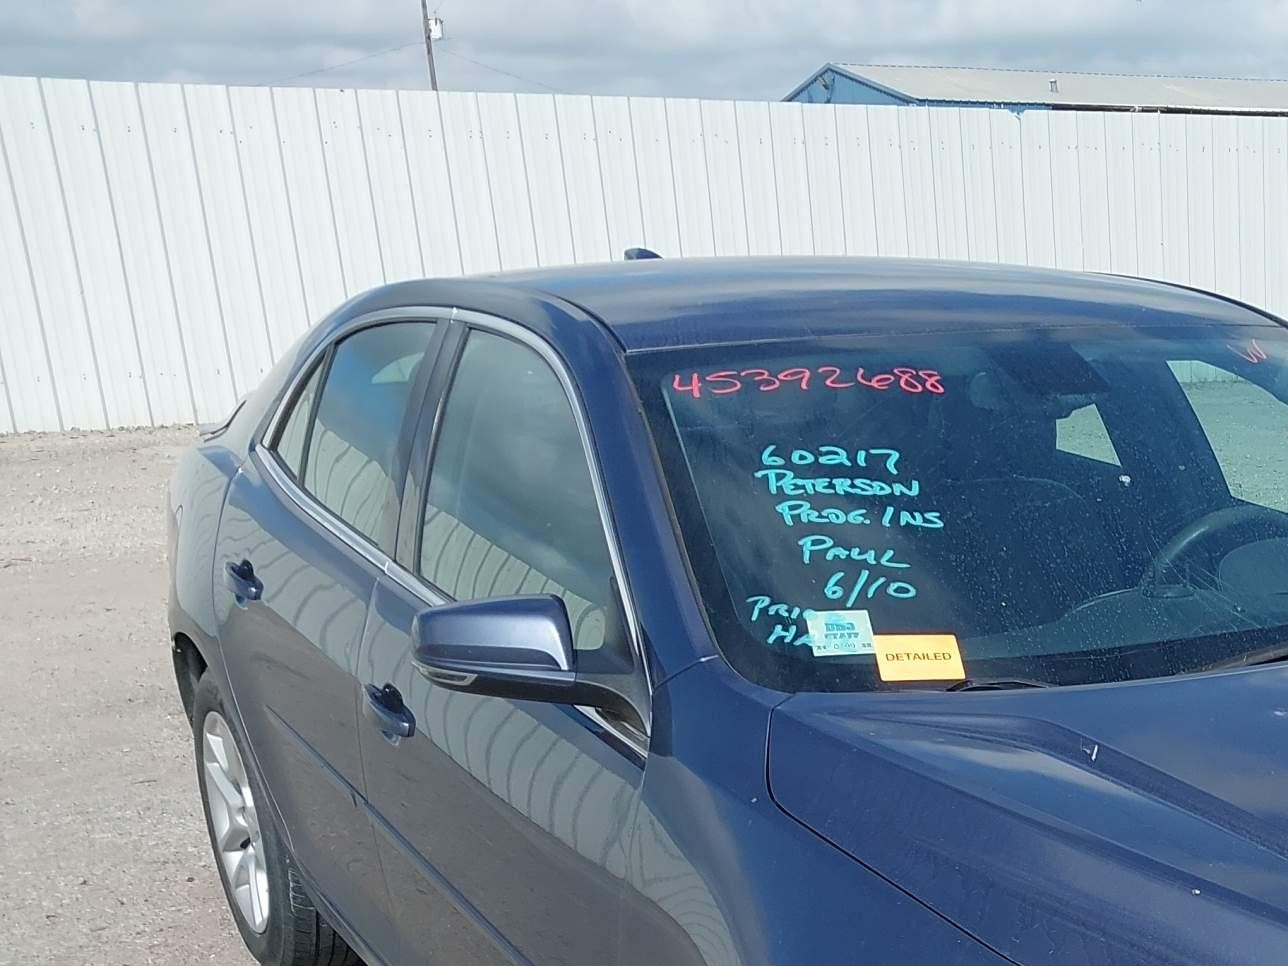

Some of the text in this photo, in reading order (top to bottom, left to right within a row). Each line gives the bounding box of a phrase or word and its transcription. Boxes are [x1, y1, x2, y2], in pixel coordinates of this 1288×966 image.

[672, 366, 945, 398] 45392688
[761, 445, 899, 475] 60217
[823, 569, 918, 608] 6/10
[885, 652, 952, 662] DETAILED
